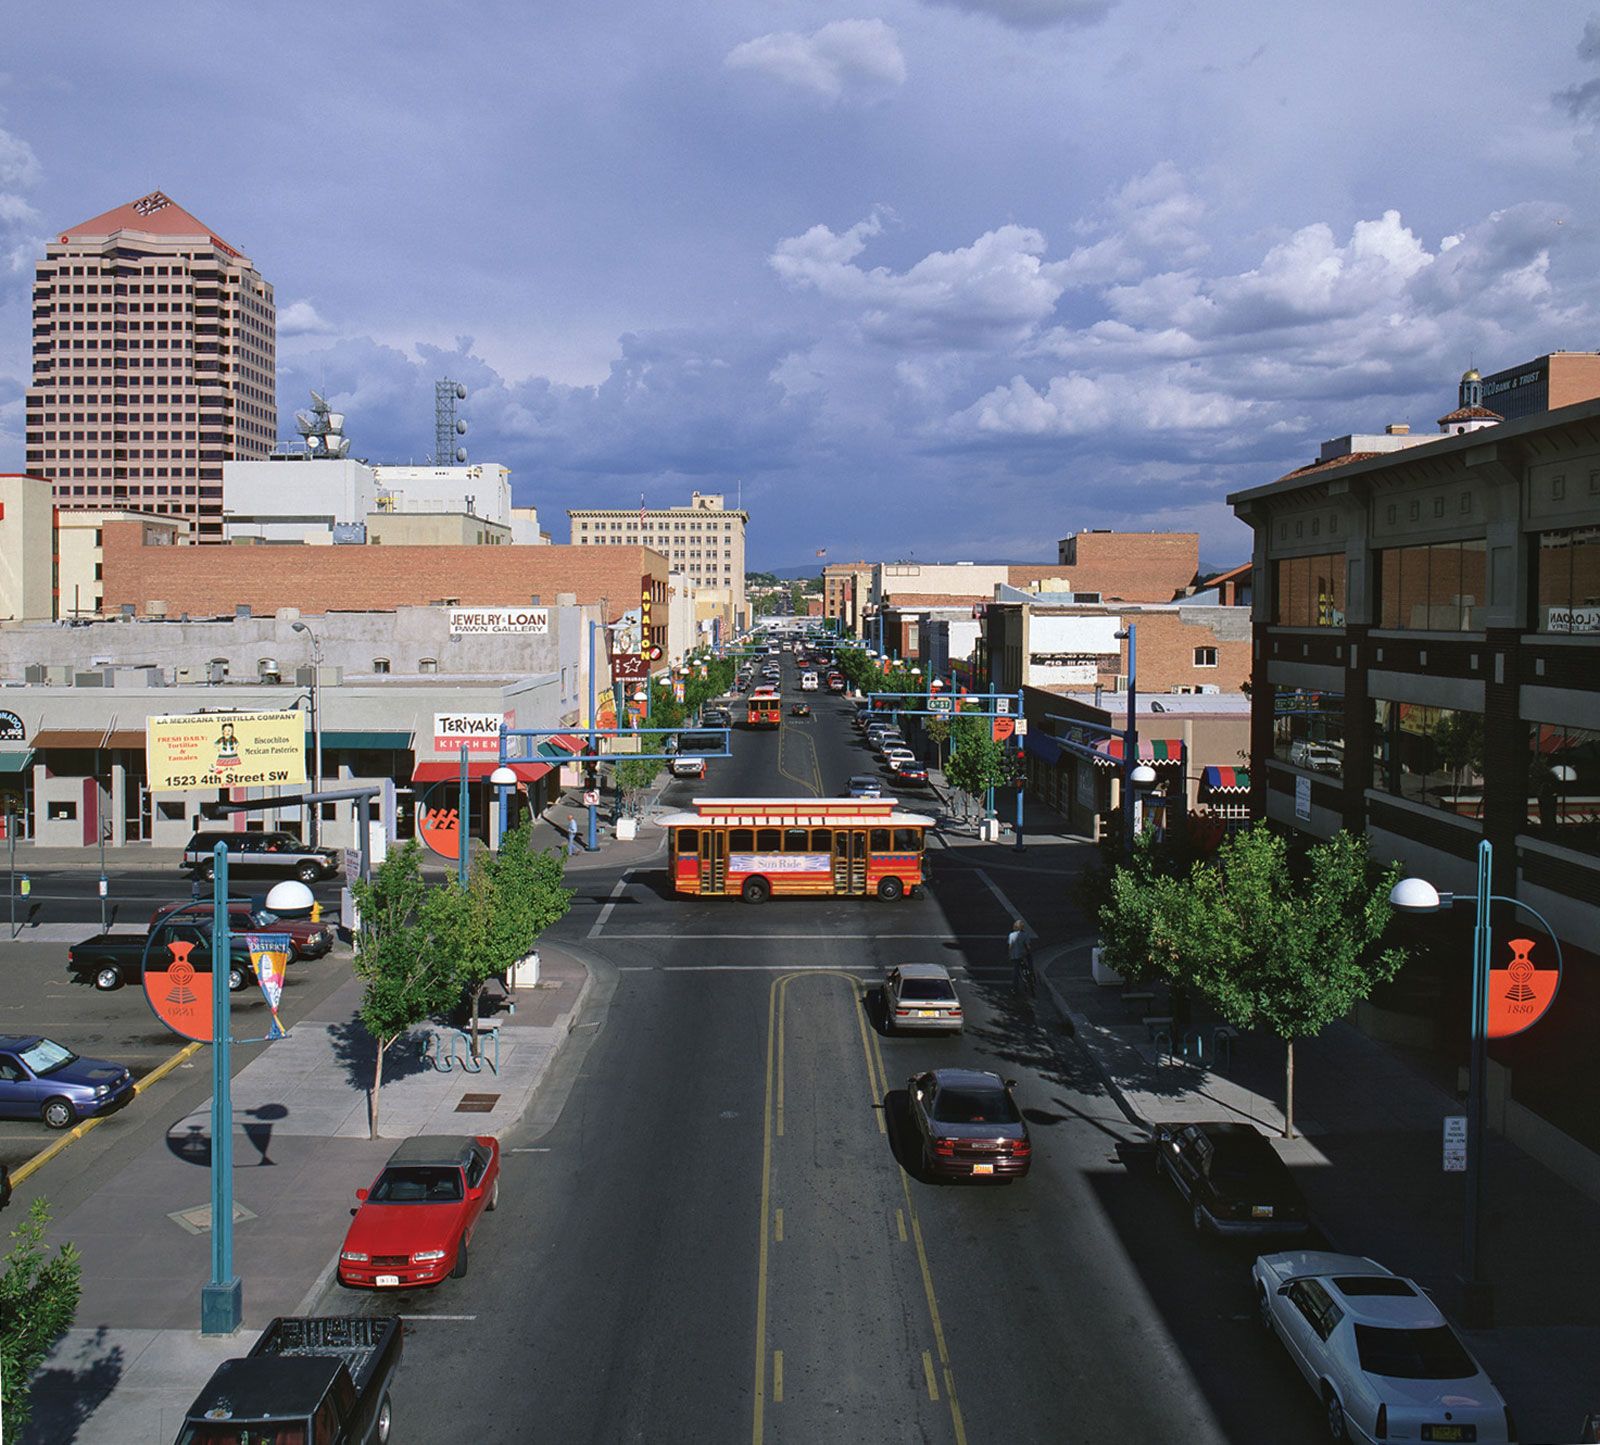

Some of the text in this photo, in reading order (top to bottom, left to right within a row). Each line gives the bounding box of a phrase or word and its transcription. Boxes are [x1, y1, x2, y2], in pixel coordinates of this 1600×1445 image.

[1495, 380, 1511, 393] BANK
[1512, 378, 1518, 389] &
[1519, 370, 1541, 386] TRUST
[451, 614, 501, 626] JEWELRY
[507, 614, 546, 626] LOAN
[641, 591, 651, 660] AVALON
[169, 717, 214, 725] MEXICANA
[439, 740, 498, 748] KITCHEN
[244, 747, 270, 756] Mexican
[168, 754, 199, 762] Tamales
[164, 770, 289, 787] 1523 4th Street SW
[251, 942, 286, 952] DISTRICT
[1507, 1004, 1535, 1014] 1880
